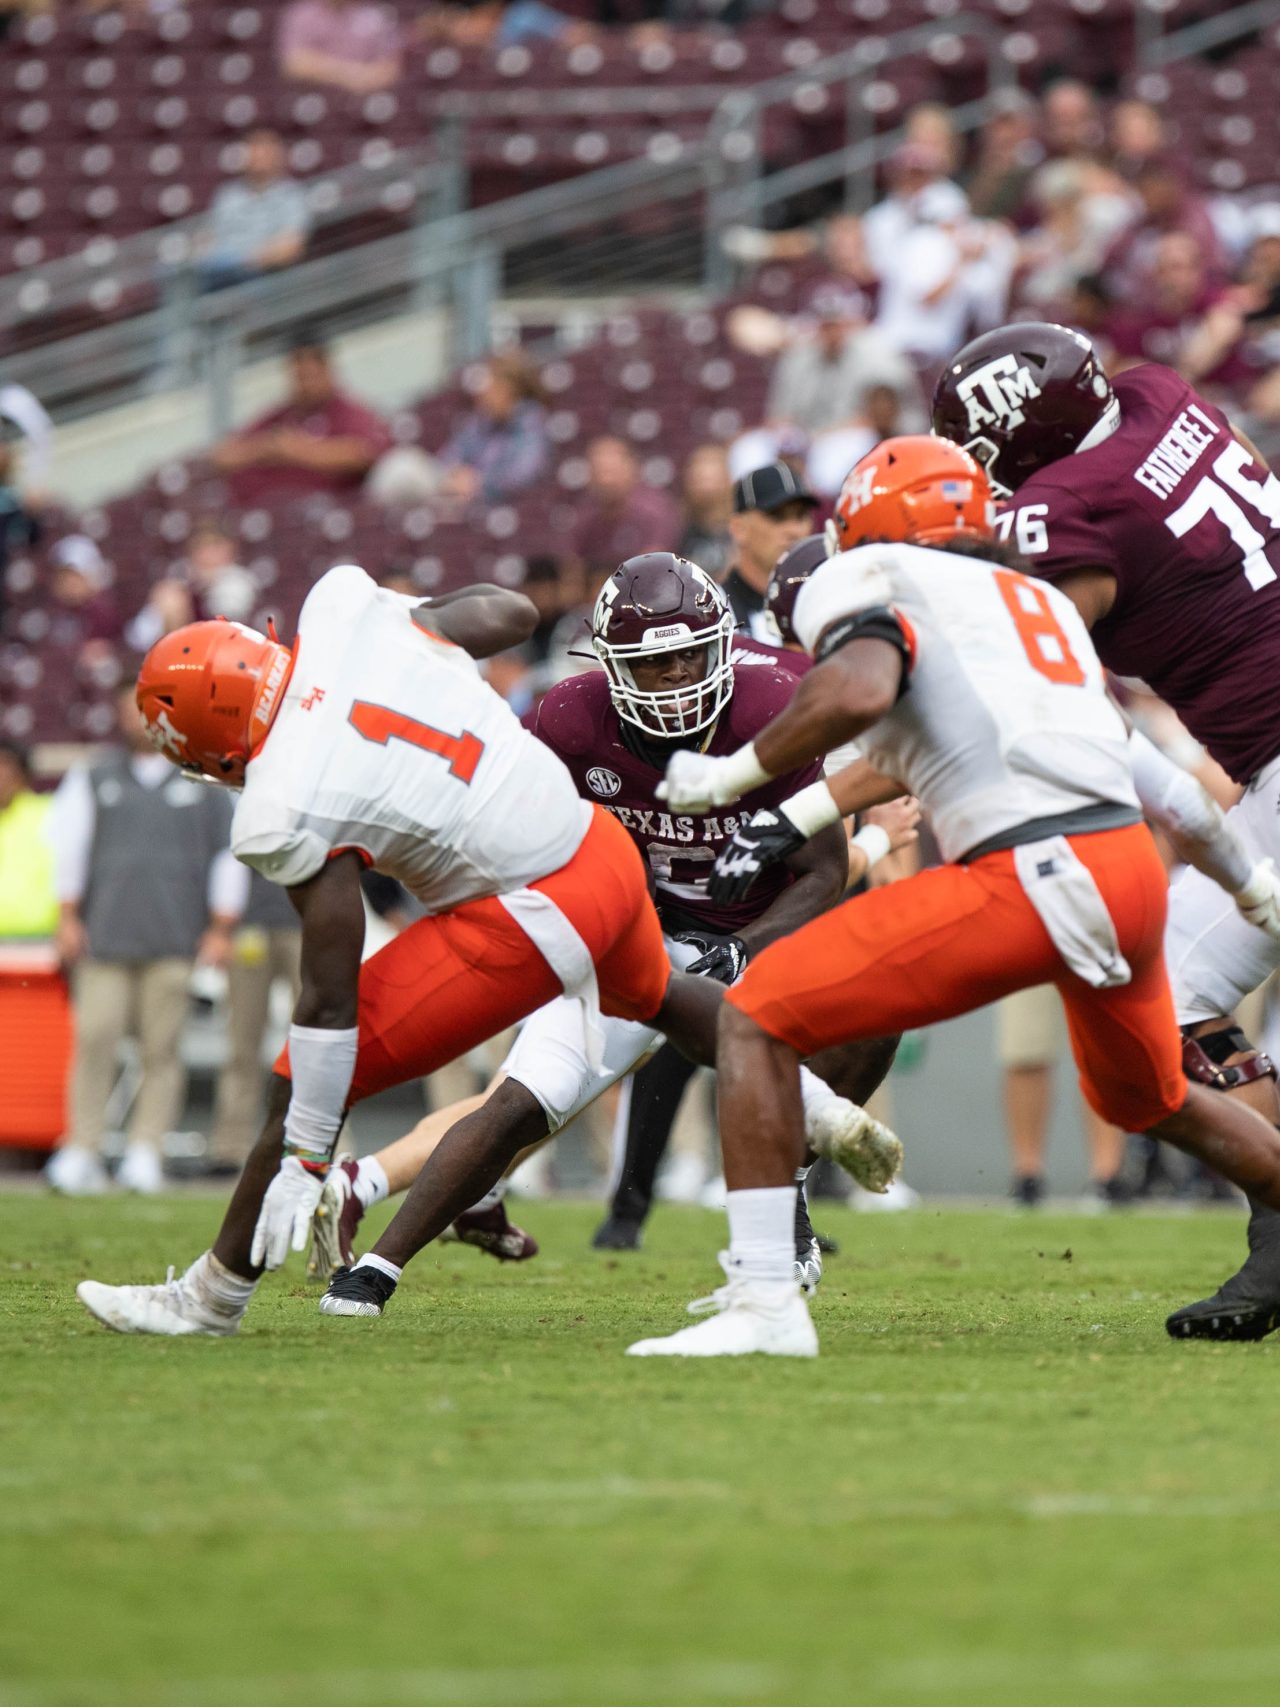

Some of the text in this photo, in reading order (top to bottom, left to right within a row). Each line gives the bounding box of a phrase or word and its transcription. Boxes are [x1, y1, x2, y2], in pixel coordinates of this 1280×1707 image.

[994, 504, 1048, 554] 76
[654, 627, 680, 639] AGGIES
[993, 569, 1086, 686] 8
[348, 699, 485, 785] 1
[589, 772, 619, 795] SEC
